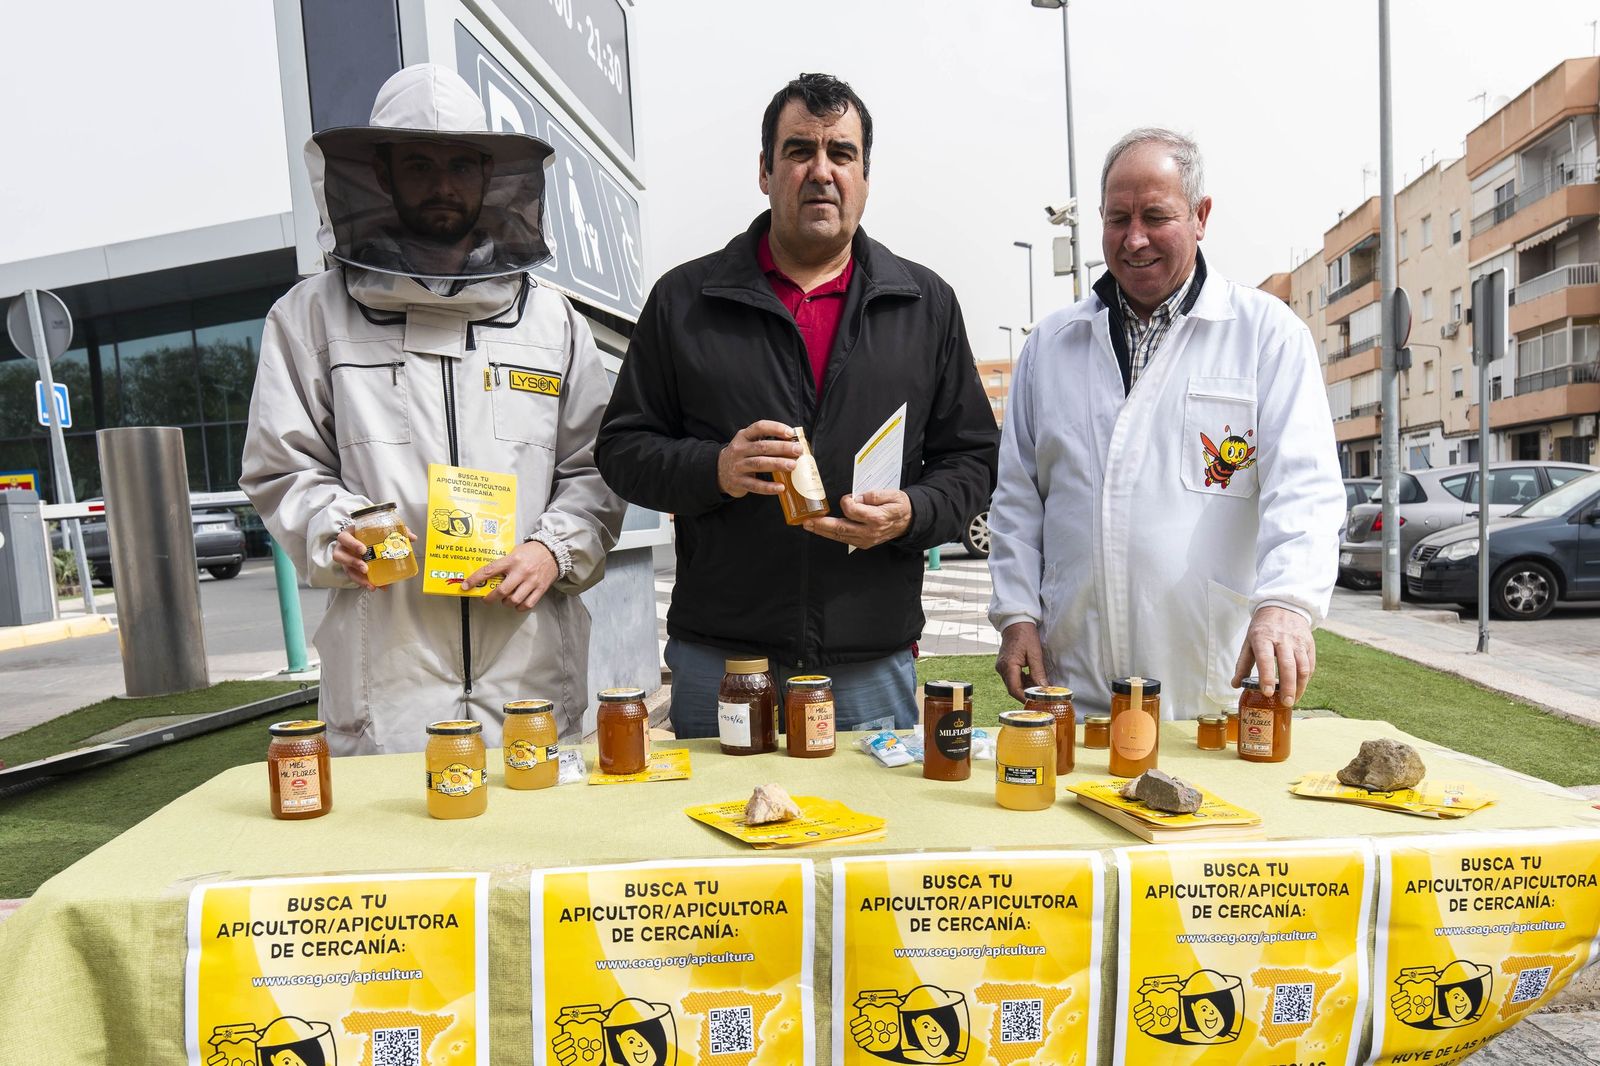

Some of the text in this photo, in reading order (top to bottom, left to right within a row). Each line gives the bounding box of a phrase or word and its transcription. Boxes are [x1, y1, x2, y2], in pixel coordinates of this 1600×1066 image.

[585, 15, 622, 94] 21:30
[436, 477, 511, 492] APICULTOR/APICULTORA
[458, 472, 478, 481] BUSCA
[478, 548, 506, 556] MEZCLAS
[431, 570, 464, 579] COAG
[292, 770, 317, 778] FLORES
[1204, 862, 1288, 877] BUSCA TU
[1461, 856, 1541, 871] BUSCA TU
[625, 881, 719, 897] BUSCA TU
[923, 874, 1012, 889] BUSCA TU
[1405, 874, 1597, 894] APICULTOR/APICULTORA
[1145, 883, 1349, 899] APICULTOR/APICULTORA
[288, 894, 387, 912] BUSCA TU
[860, 895, 1078, 911] APICULTOR/APICULTORA
[1192, 900, 1305, 919] DE CERCANÍA:
[1450, 892, 1555, 912] DE CERCANÍA:
[560, 900, 788, 922] APICULTOR/APICULTORA
[217, 914, 459, 938] APICULTOR/APICULTORA
[910, 913, 1030, 932] DE CERCANÍA:
[1435, 921, 1566, 936] www.coag.org/apicultura
[612, 921, 738, 942] DE CERCANÍA:
[1176, 931, 1317, 944] www.coag.org/apicultura
[271, 934, 406, 958] DE CERCANÍA:
[895, 944, 1046, 958] www.coag.org/apicultura
[596, 952, 754, 970] www.coag.org/apicultura
[252, 969, 423, 987] www.coag.org/apicultura
[1392, 1050, 1433, 1064] HUYE
[1435, 1045, 1452, 1058] DE
[1454, 1040, 1478, 1052] LAS
